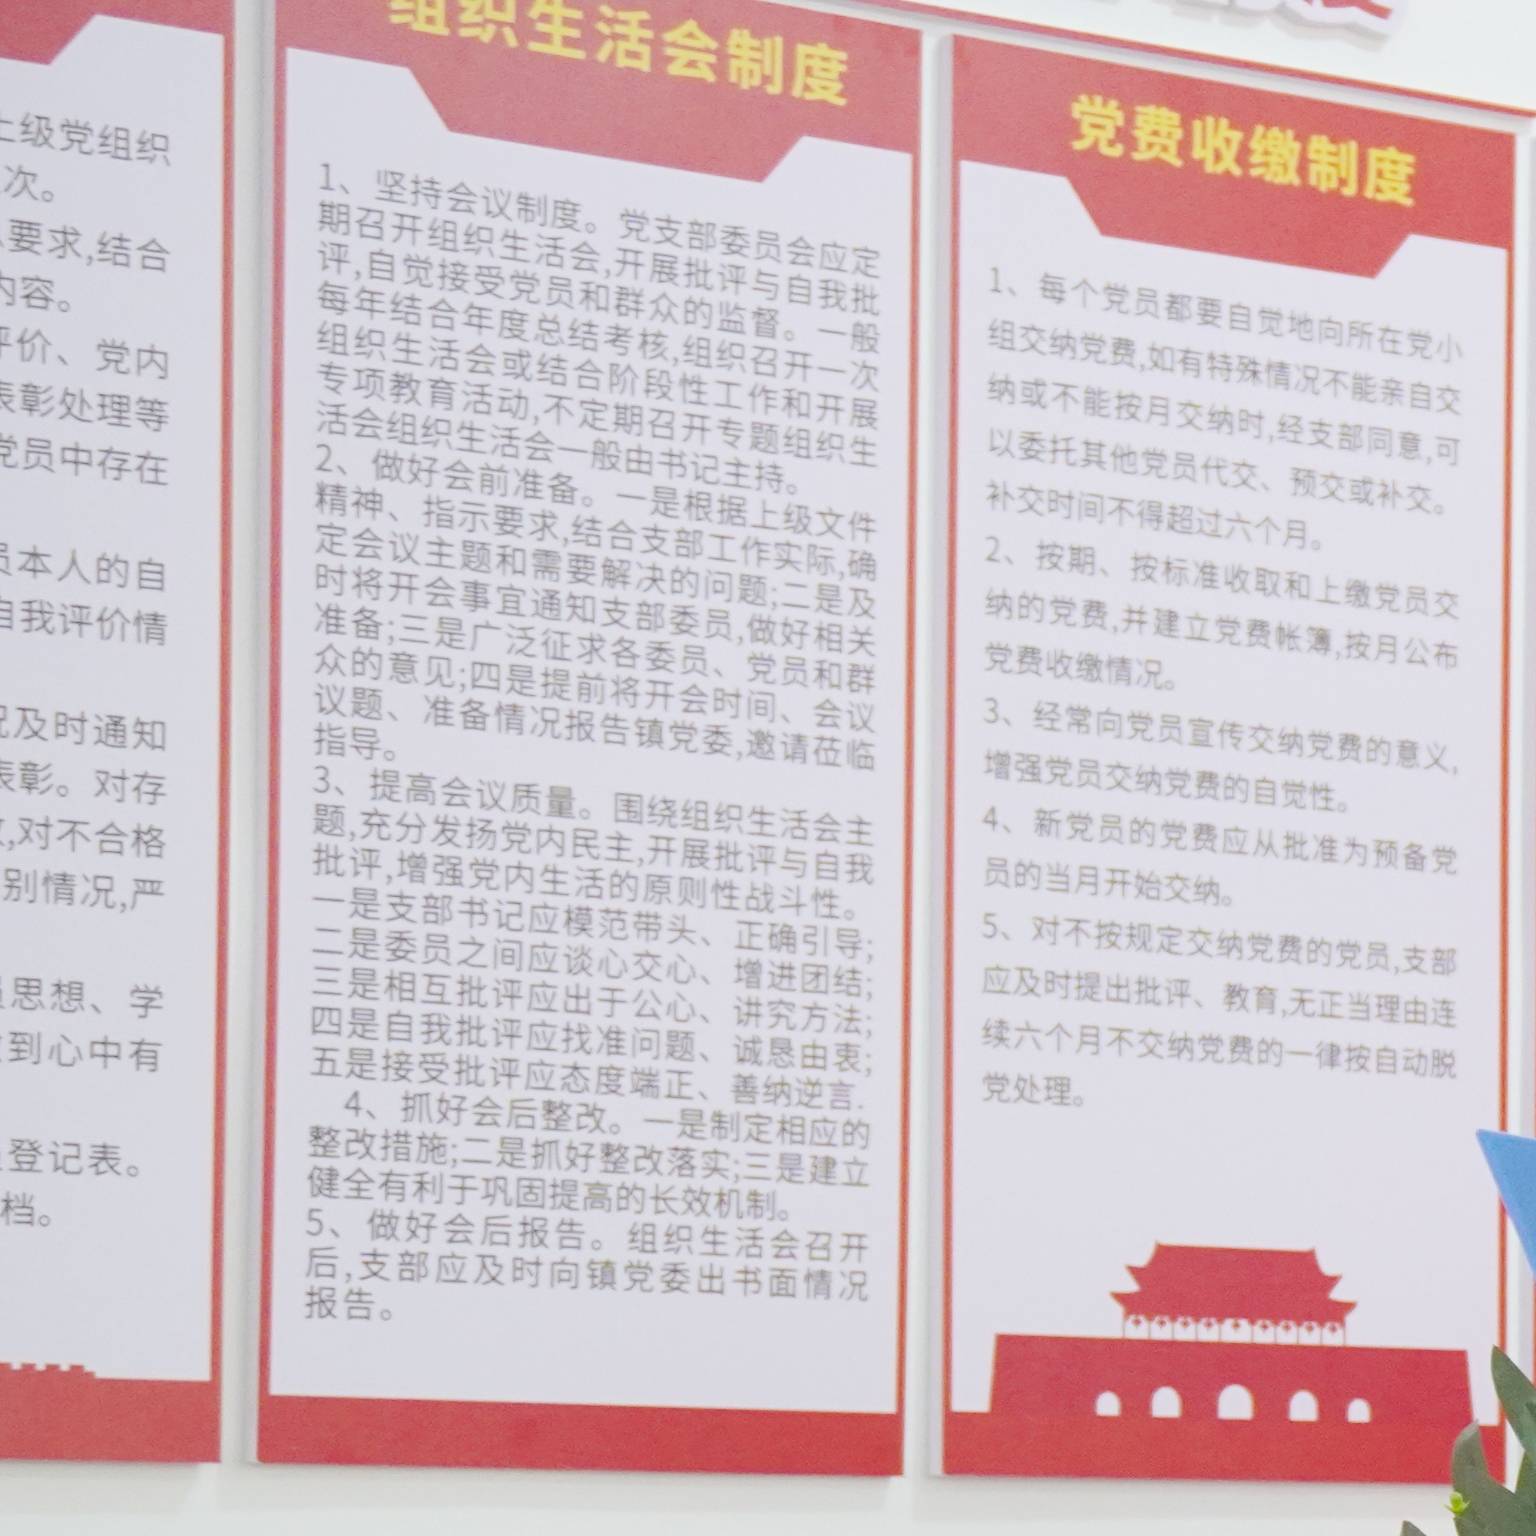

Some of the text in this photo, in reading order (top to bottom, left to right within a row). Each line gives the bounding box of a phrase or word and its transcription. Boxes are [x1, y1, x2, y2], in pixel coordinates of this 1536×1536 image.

[388, 0, 849, 106] 组织生活会制度
[1071, 94, 1416, 207] 党费收缴制度
[0, 219, 170, 272] 要求,结合
[0, 705, 166, 751] 及时通知
[0, 815, 166, 859] ,对不合格
[0, 976, 163, 1019] 思想、学
[0, 1031, 163, 1073] 到心中有
[0, 1138, 140, 1178] 登记表。
